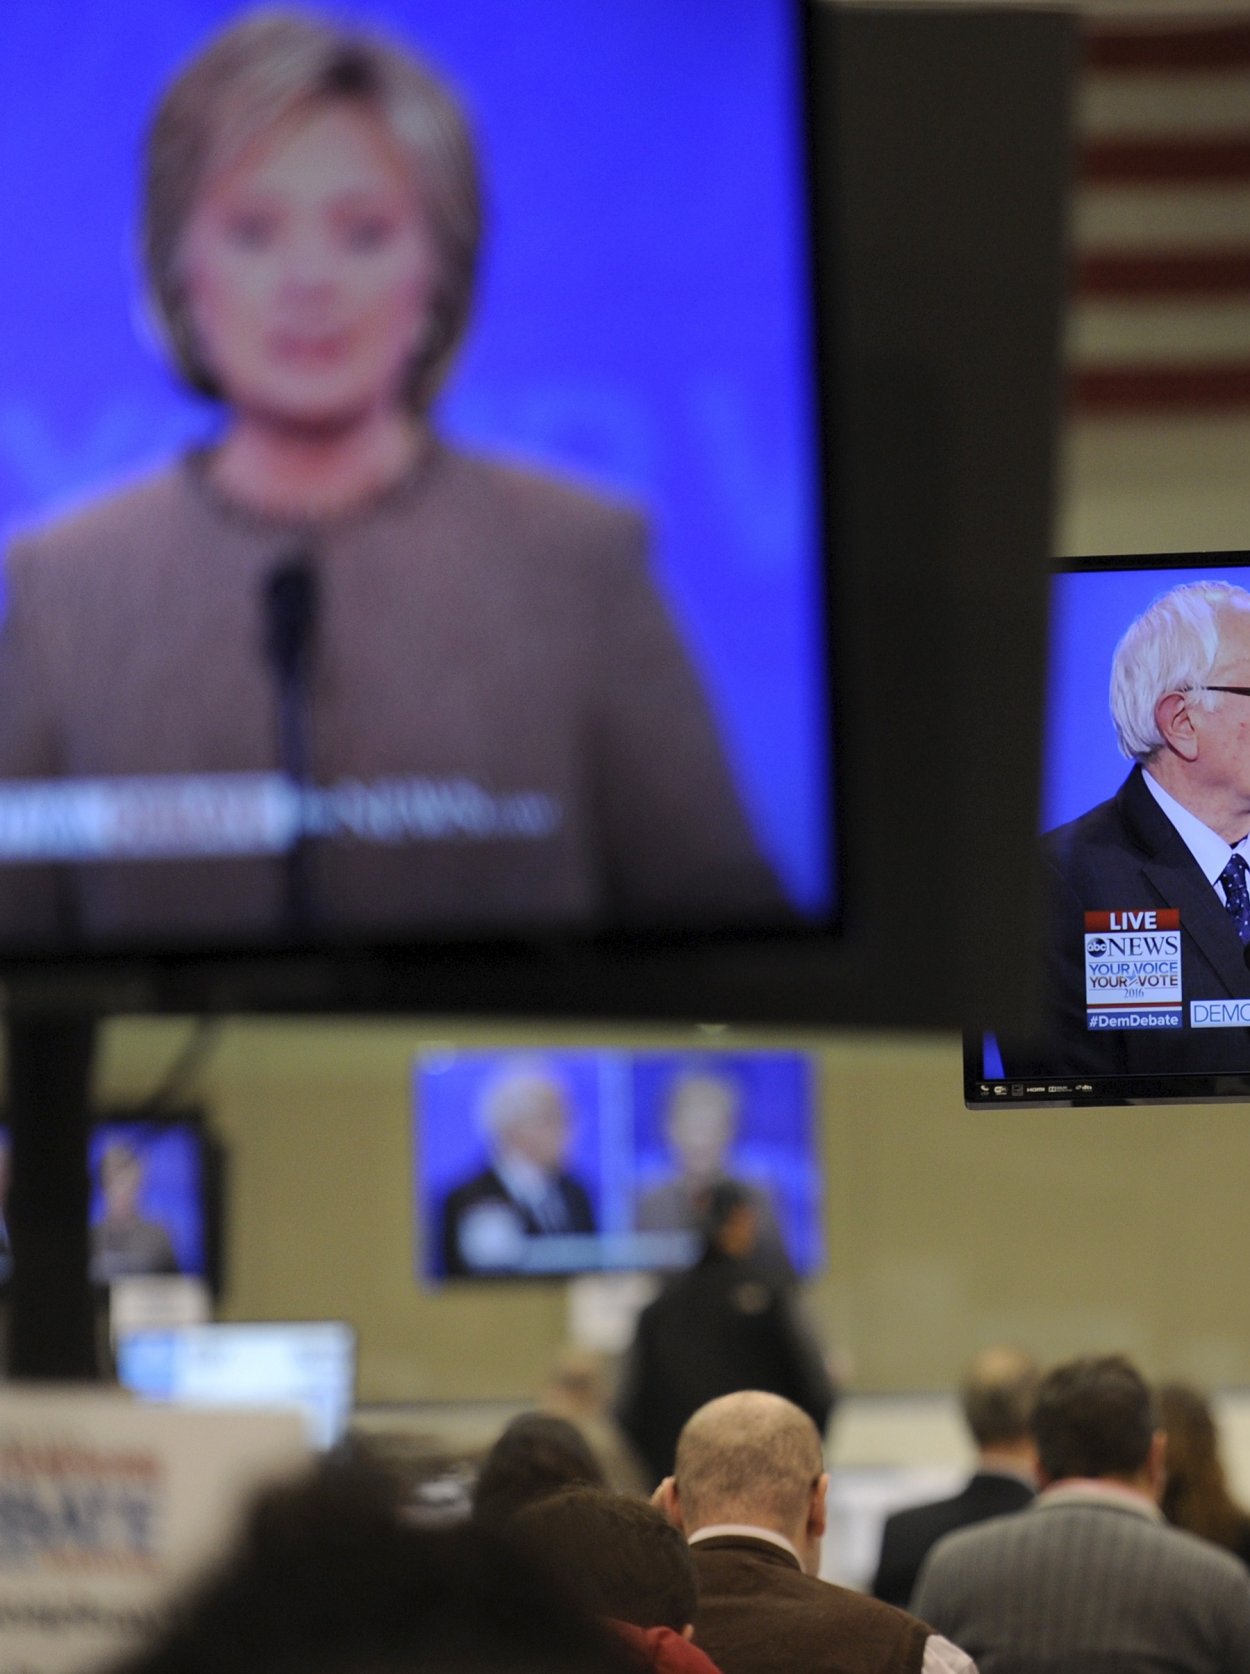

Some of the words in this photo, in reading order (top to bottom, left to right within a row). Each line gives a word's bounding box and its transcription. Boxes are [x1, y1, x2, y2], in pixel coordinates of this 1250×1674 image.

[1110, 911, 1157, 930] LIVE
[1108, 936, 1178, 957] NEWS
[1089, 963, 1130, 976] YOUR
[1134, 961, 1178, 974] VOICE
[1089, 976, 1128, 988] YOUR
[1138, 974, 1178, 987] VOTE
[1124, 988, 1144, 998] 2016
[1089, 1014, 1178, 1028] #DemDebate
